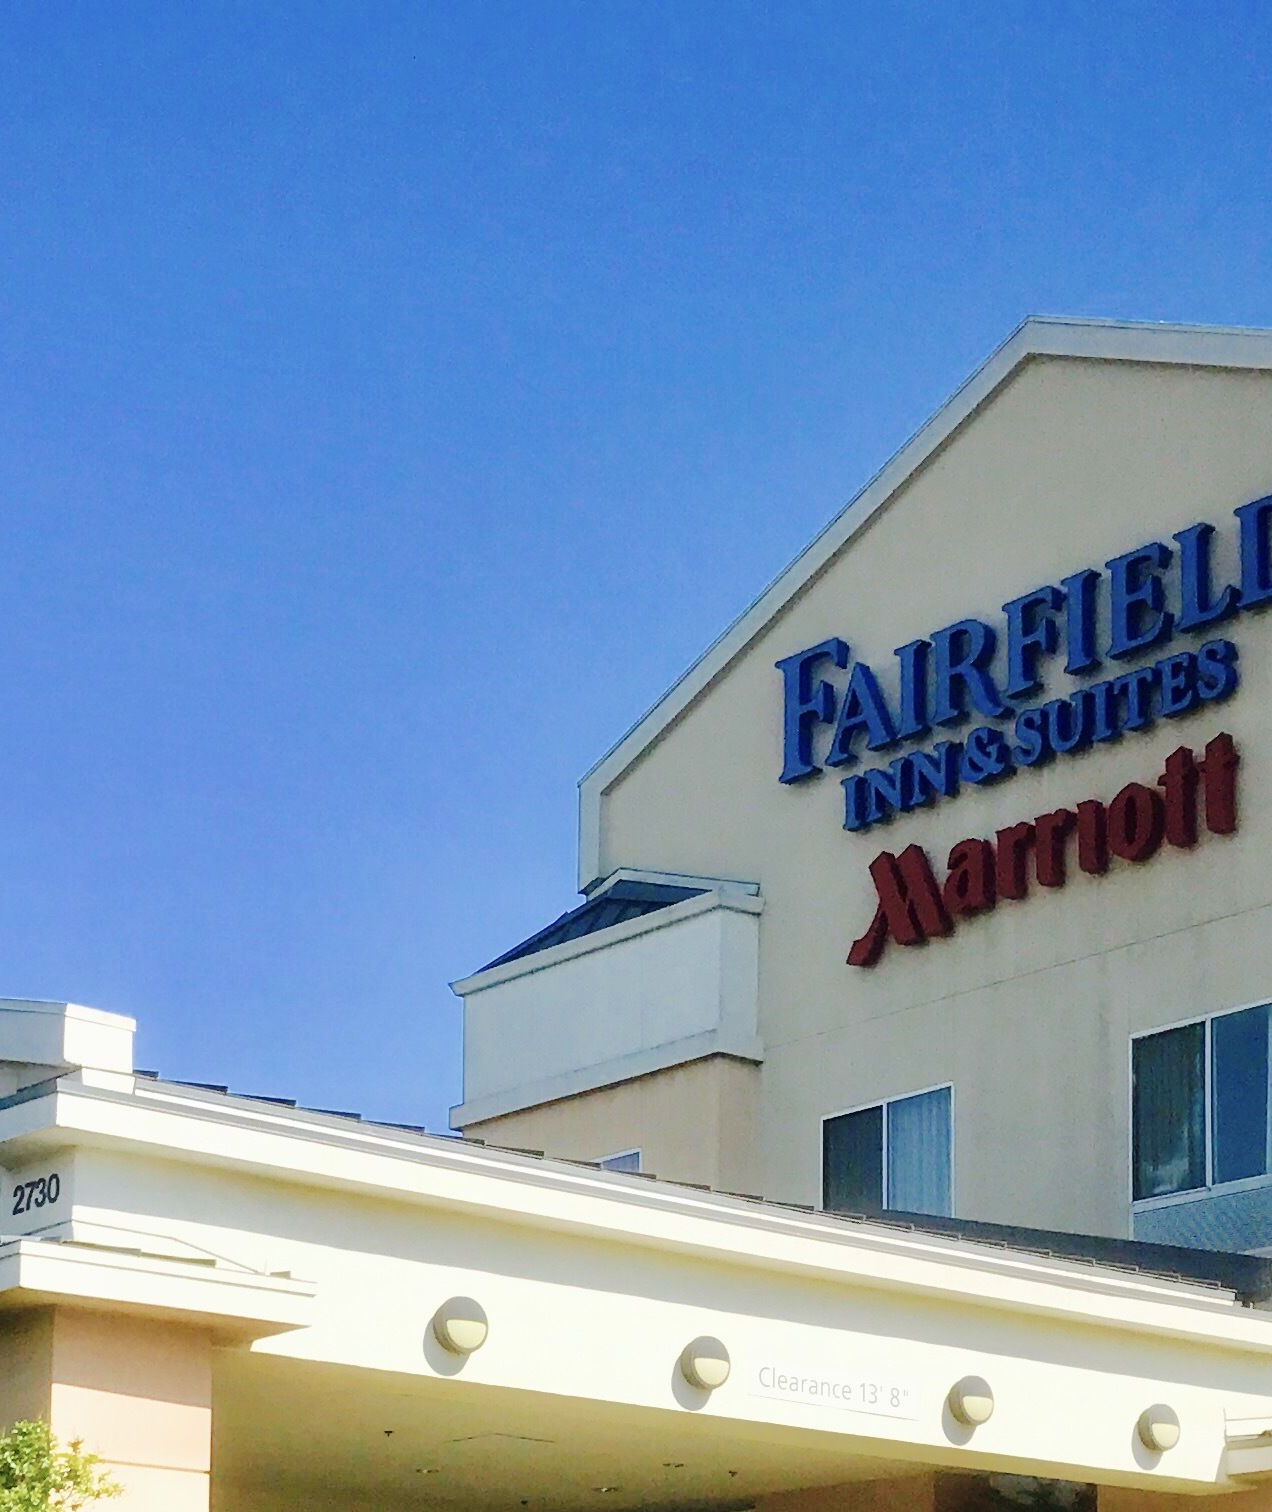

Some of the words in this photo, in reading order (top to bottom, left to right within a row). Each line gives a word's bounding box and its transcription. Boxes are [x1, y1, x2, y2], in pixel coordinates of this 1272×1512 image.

[846, 732, 1240, 967] Marriott
[12, 1173, 60, 1216] 2730
[758, 1366, 852, 1401] Clearance
